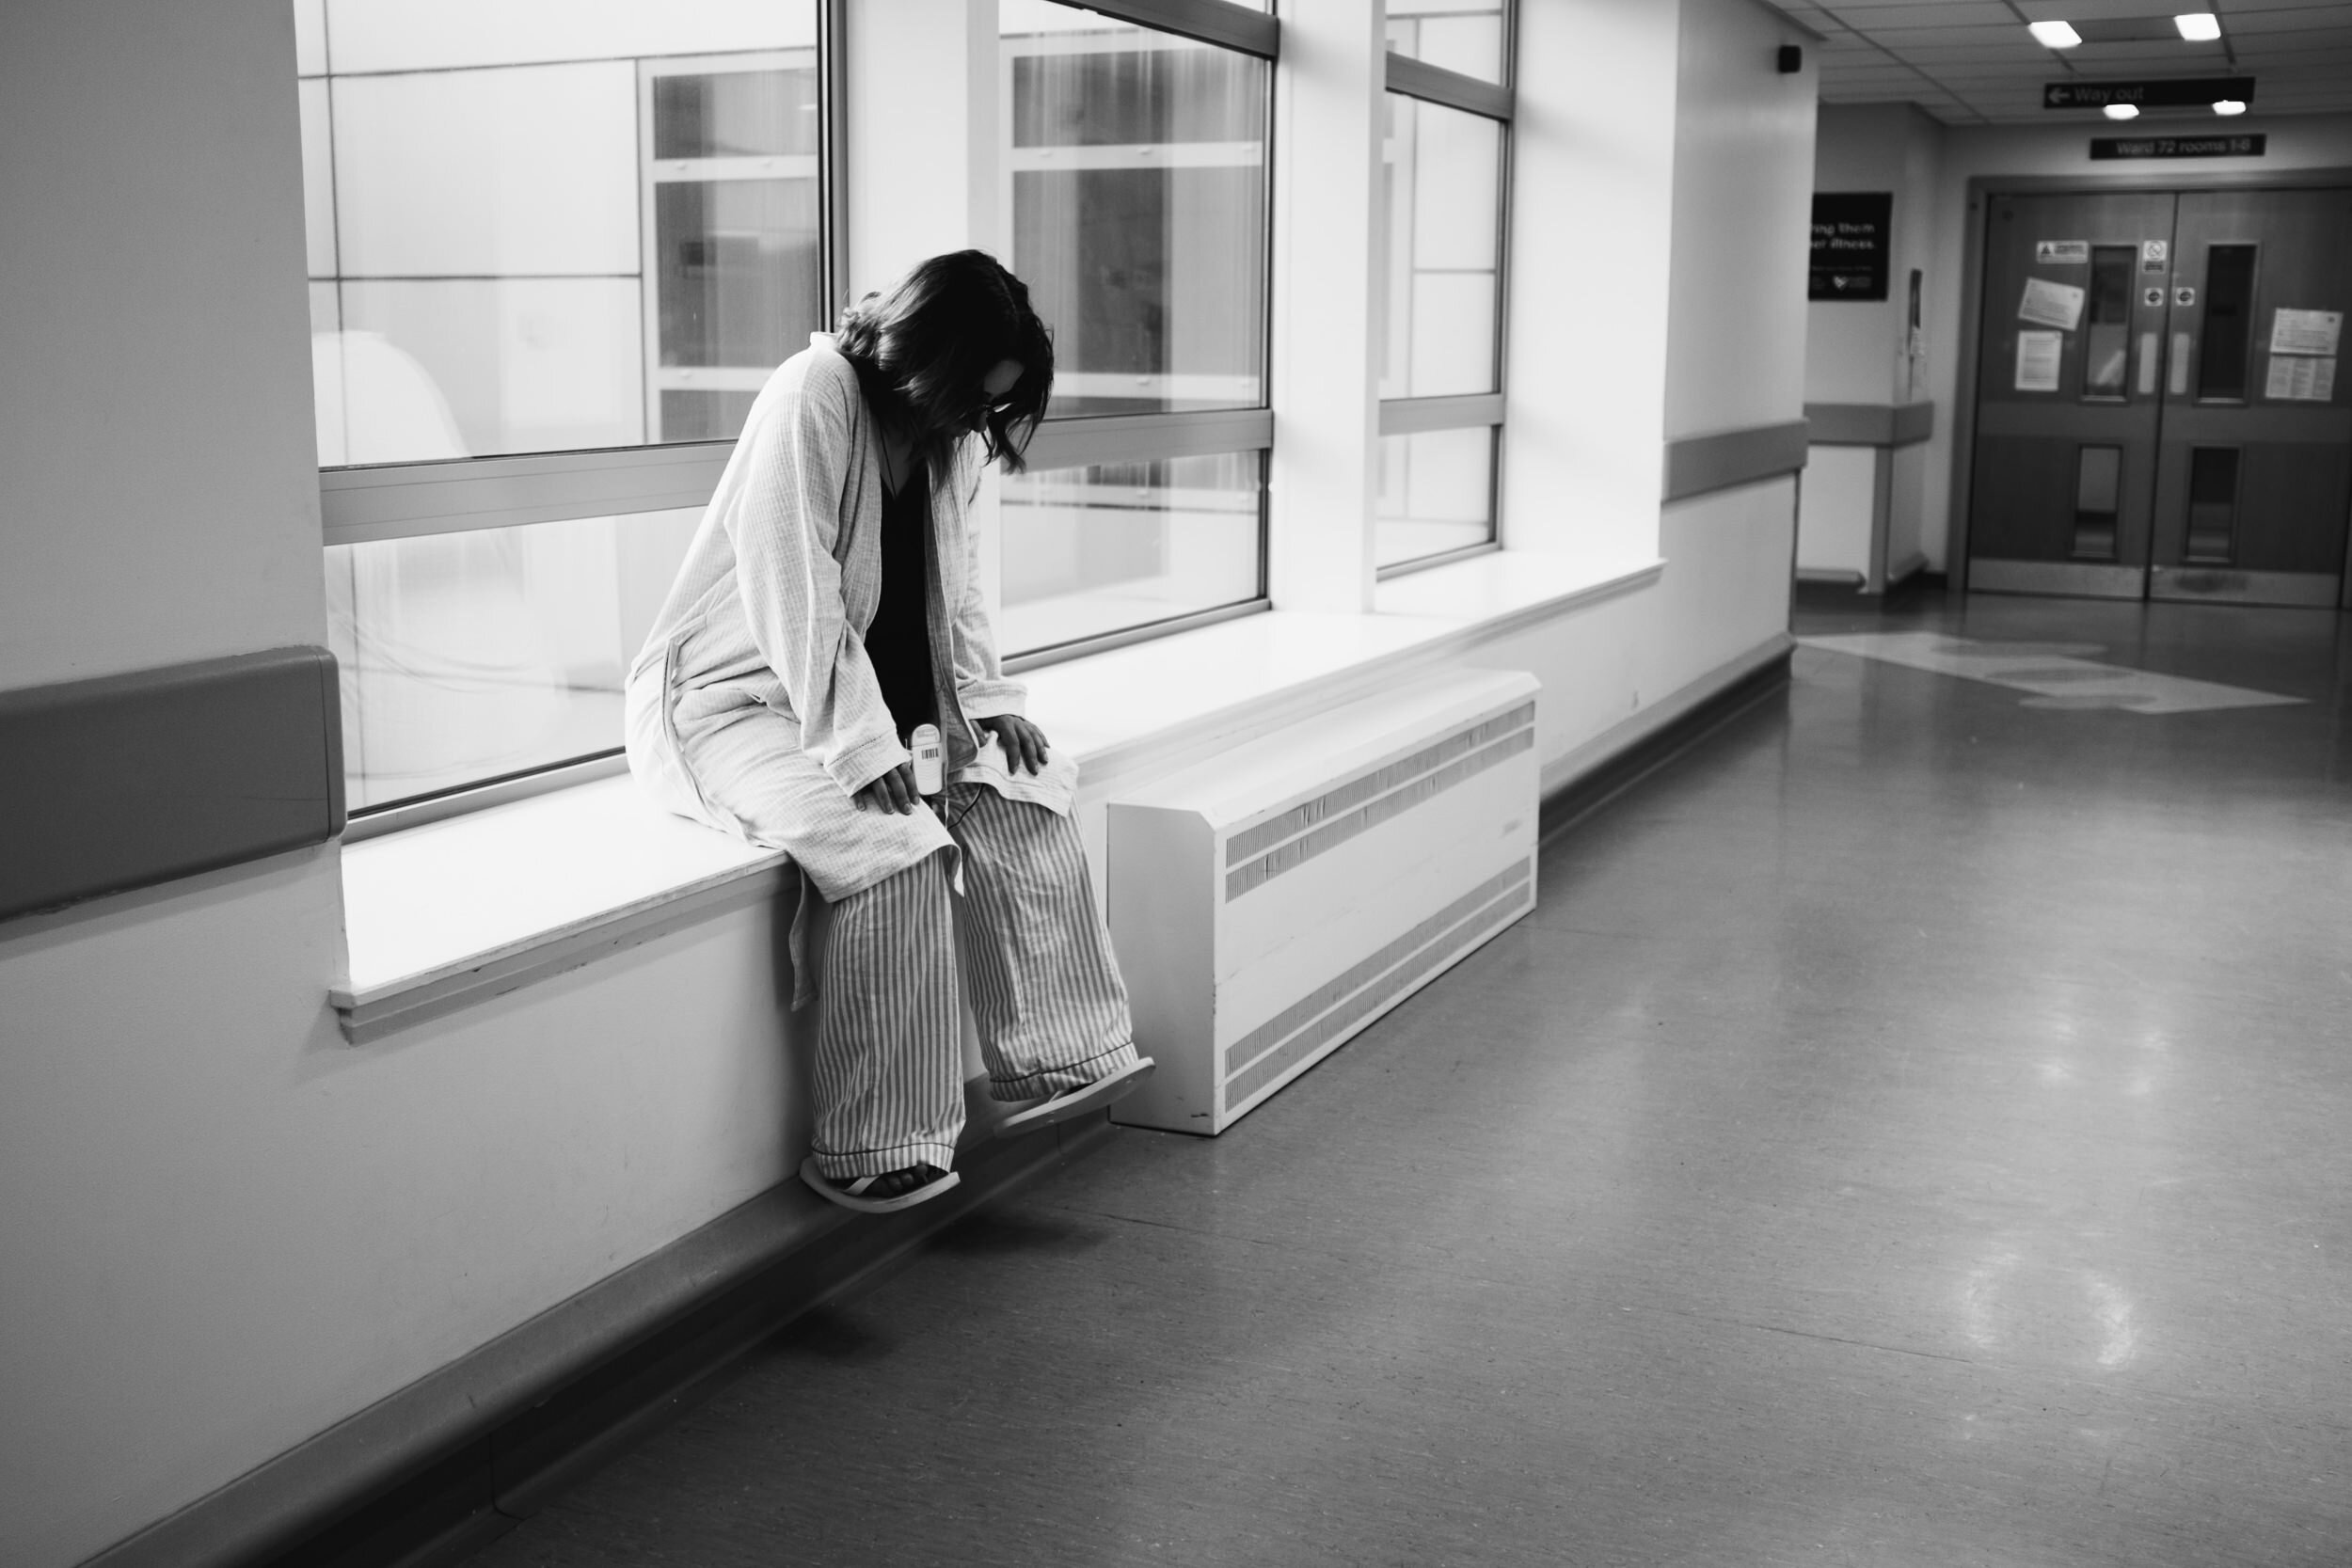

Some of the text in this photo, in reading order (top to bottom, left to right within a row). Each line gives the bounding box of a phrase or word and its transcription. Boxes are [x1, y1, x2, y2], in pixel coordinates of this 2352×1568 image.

[2074, 86, 2144, 104] Way out
[2117, 141, 2154, 155] Ward
[2158, 140, 2176, 154] 72
[2179, 141, 2226, 153] rooms
[1837, 222, 1875, 234] them
